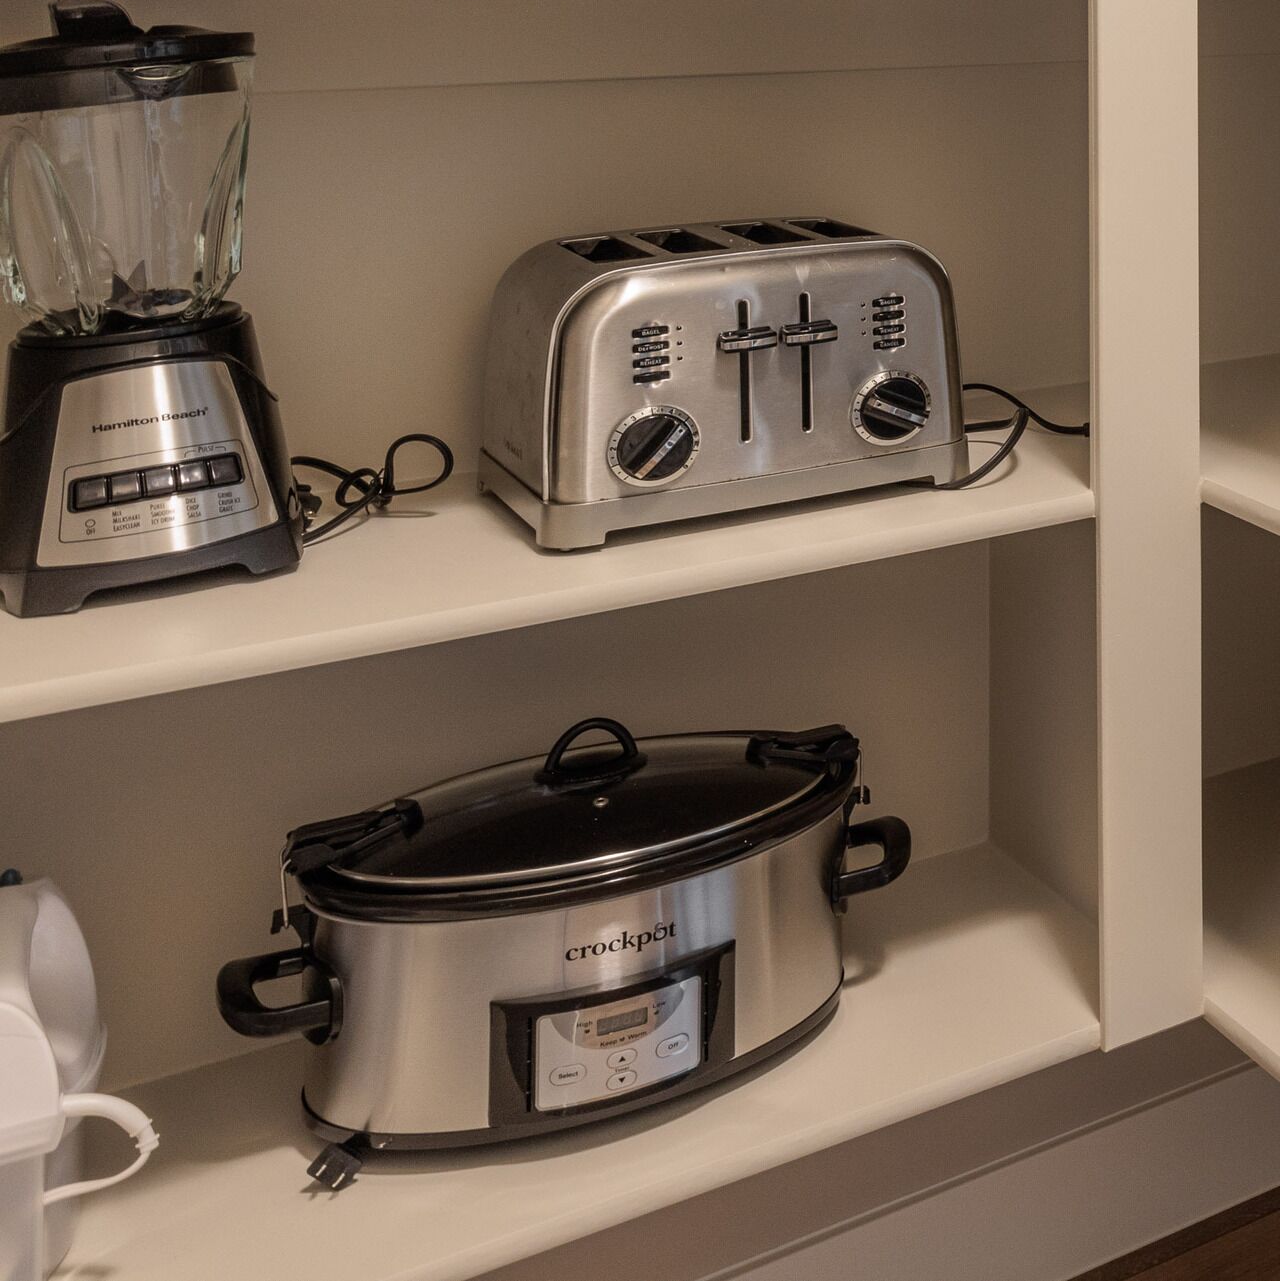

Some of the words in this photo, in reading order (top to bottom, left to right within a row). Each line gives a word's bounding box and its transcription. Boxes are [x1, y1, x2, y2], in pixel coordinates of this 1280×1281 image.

[638, 343, 664, 352] DEFROST
[92, 415, 159, 434] Hamilton
[185, 497, 196, 505] DICE
[112, 514, 141, 524] MILKSHAKE
[113, 522, 141, 532] EASYCLEAN
[86, 528, 96, 536] OFF
[565, 920, 677, 961] crockpot
[652, 1001, 666, 1009] Low
[576, 1020, 593, 1029] High
[627, 1031, 647, 1040] Warm
[668, 1042, 679, 1050] Off
[558, 1071, 579, 1080] Select
